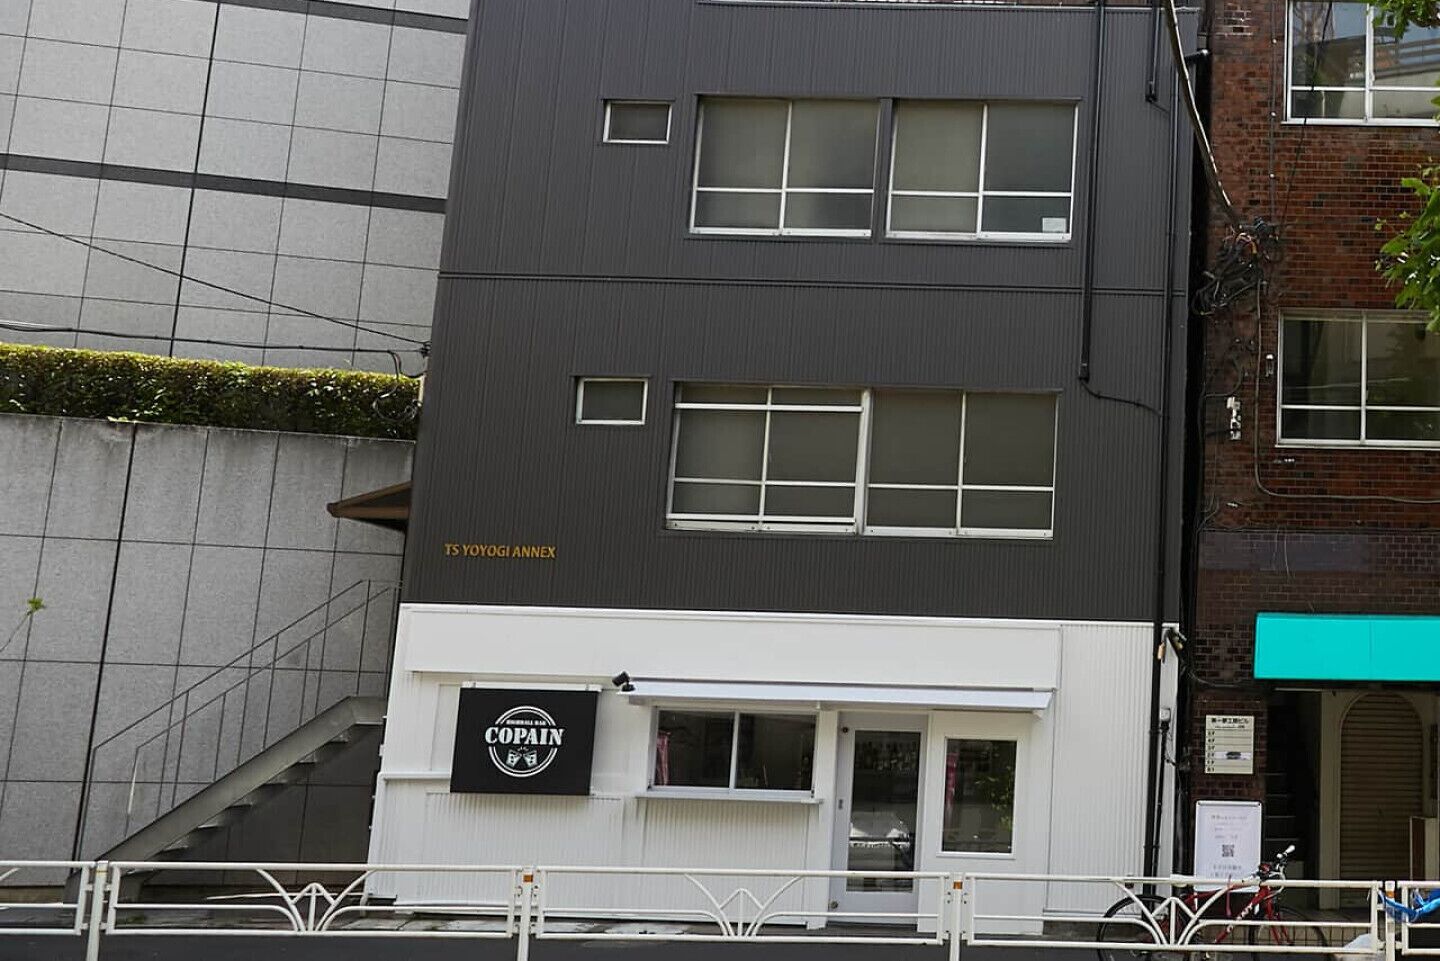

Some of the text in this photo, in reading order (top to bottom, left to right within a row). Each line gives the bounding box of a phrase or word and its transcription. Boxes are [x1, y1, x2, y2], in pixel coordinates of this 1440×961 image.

[445, 543, 556, 558] TS YOYOGI ANNEX
[485, 726, 565, 746] COPAIN
